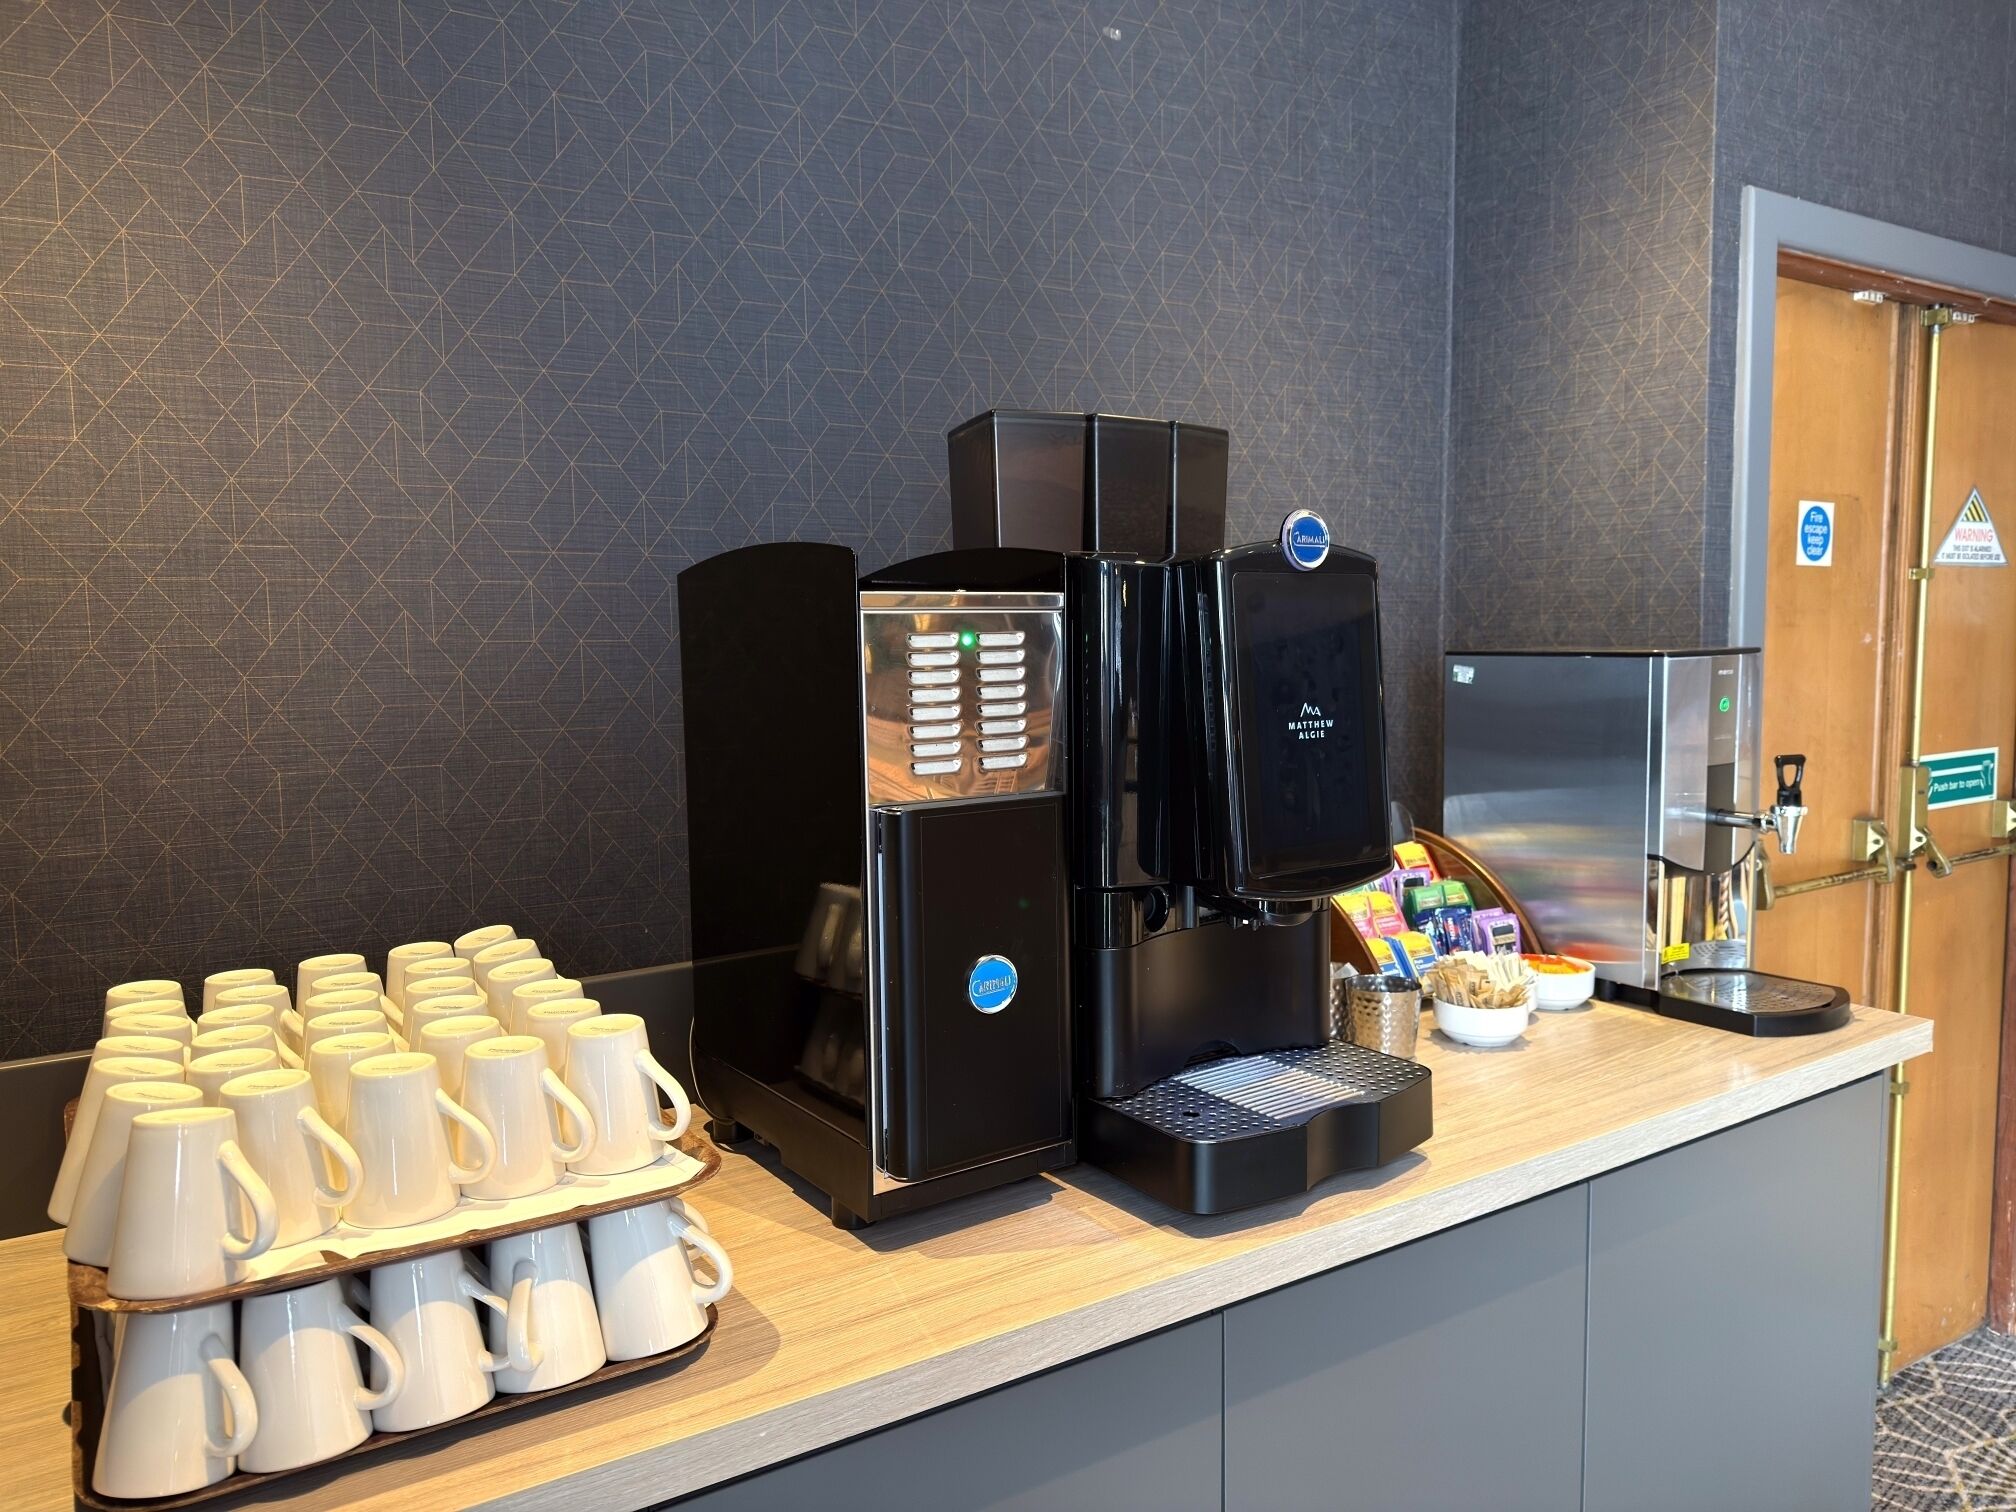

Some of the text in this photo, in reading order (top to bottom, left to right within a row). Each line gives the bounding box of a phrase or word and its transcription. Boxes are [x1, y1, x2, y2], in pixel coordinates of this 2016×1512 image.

[1810, 511, 1823, 523] Fire
[1804, 524, 1828, 536] escape
[1955, 528, 1993, 542] WARNING
[1807, 533, 1824, 546] keep
[1807, 545, 1823, 556] clear
[1288, 720, 1334, 730] MATTHEW
[1298, 730, 1325, 740] ALGIE
[1934, 779, 1981, 792] Push bar to open
